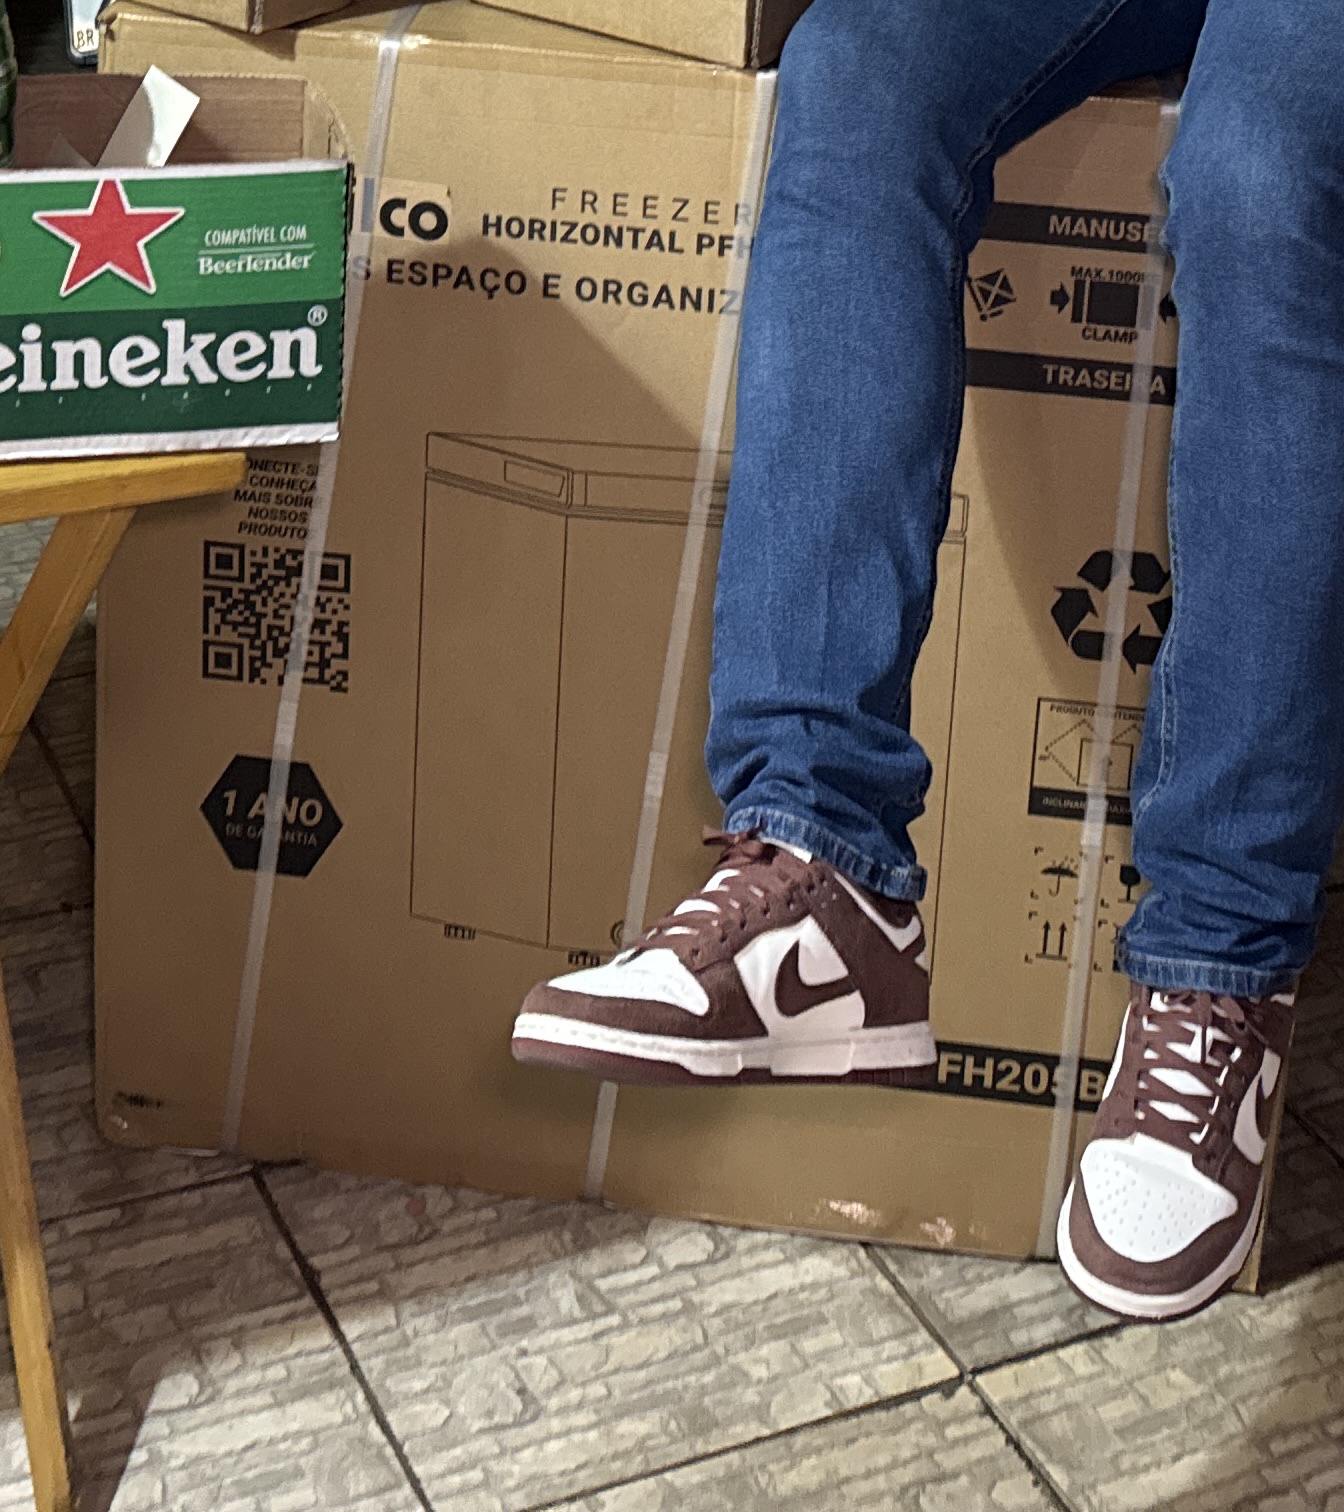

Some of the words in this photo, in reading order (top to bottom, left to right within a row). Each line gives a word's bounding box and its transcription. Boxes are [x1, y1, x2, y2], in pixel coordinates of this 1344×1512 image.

[76, 28, 95, 49] BR
[550, 187, 753, 227] FREEZER
[204, 224, 277, 247] COMPATÍVEL
[279, 224, 308, 241] COM
[482, 212, 685, 254] HORIZONTAL
[386, 257, 528, 300] ESPAÇO
[542, 273, 562, 299] E
[1081, 326, 1139, 345] CLAMP
[1042, 363, 1166, 396] TRASEIA
[234, 489, 272, 505] MAIS
[274, 493, 314, 510] SOBR
[248, 506, 309, 524] NOSSOS
[238, 520, 308, 541] PRODUTO
[223, 789, 237, 818] 1
